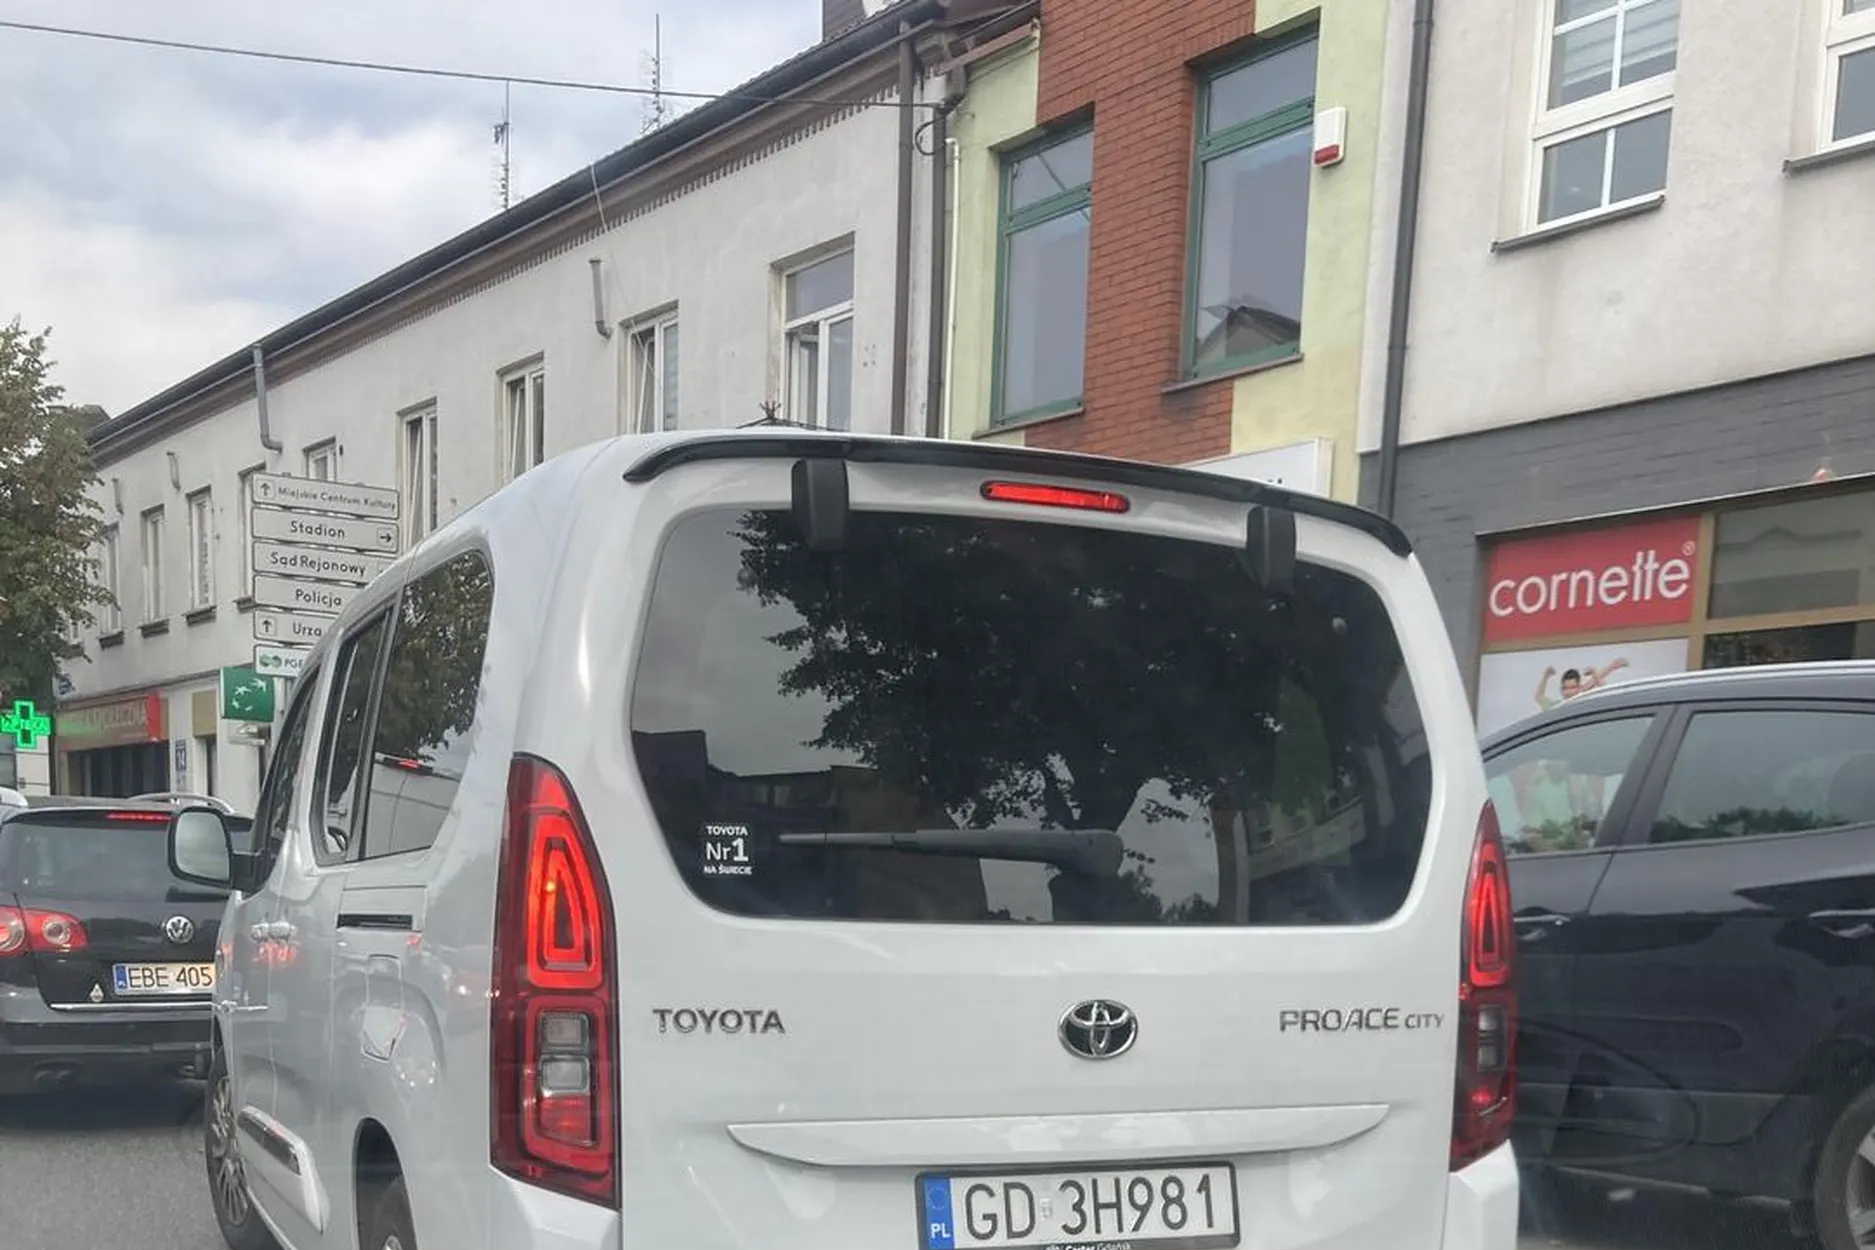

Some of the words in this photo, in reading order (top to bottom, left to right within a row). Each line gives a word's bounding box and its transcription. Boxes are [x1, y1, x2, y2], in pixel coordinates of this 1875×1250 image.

[290, 520, 346, 538] Stadion
[300, 555, 366, 577] Rejonowy
[1489, 549, 1691, 617] cornette
[295, 589, 342, 608] Policja
[706, 825, 749, 836] TOYOTA
[703, 866, 717, 874] NA
[128, 967, 169, 988] EBE
[176, 966, 213, 987] 405
[652, 1008, 786, 1034] TOYOTA
[1405, 1013, 1444, 1030] CITY
[964, 1181, 1036, 1241] GD
[1058, 1173, 1215, 1236] 3H981
[930, 1223, 951, 1239] PL
